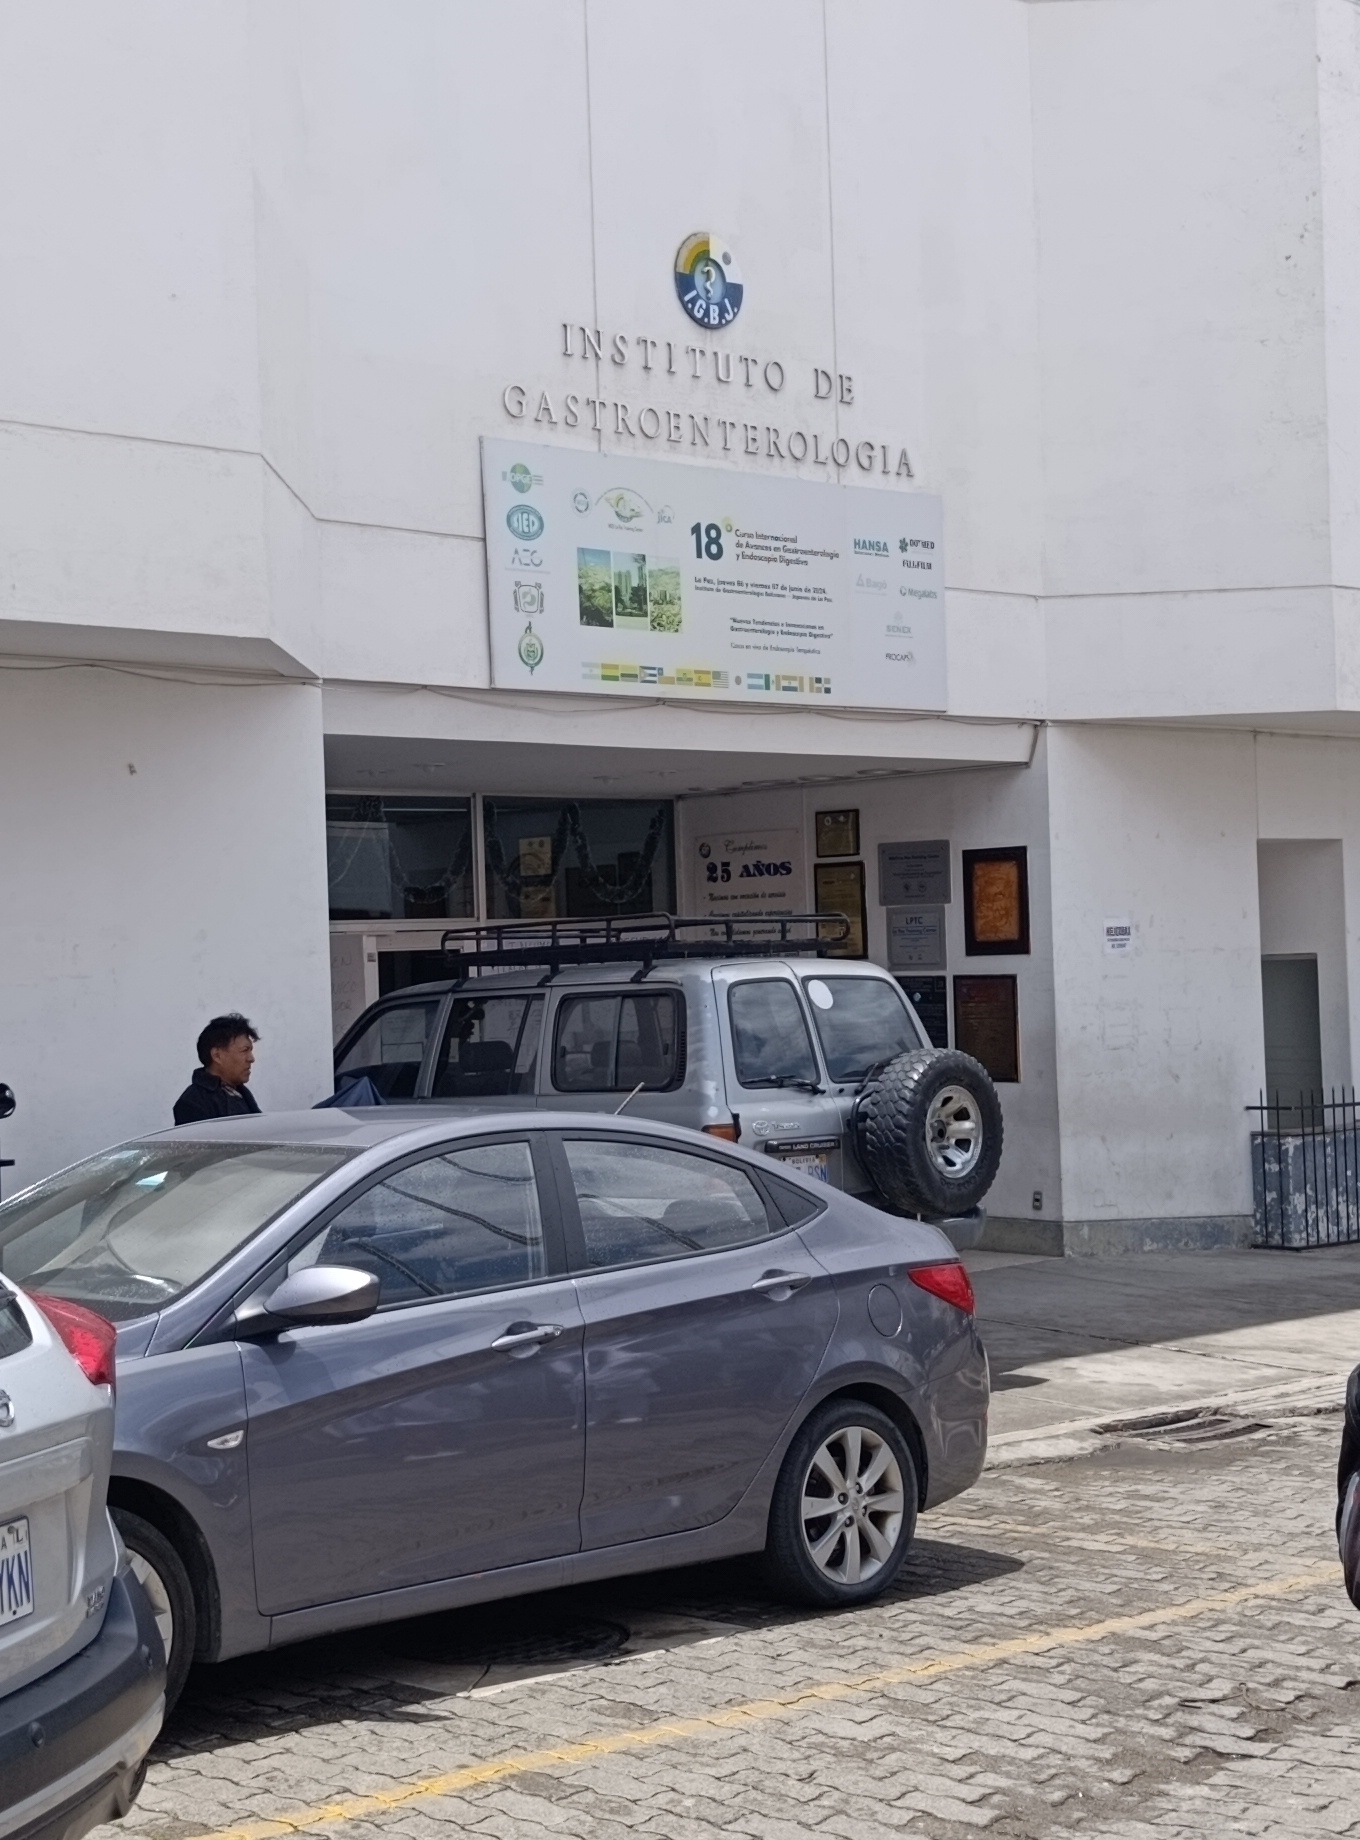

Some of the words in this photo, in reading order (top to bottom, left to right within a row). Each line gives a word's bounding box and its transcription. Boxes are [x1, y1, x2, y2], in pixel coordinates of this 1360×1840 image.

[561, 322, 785, 392] INSTITUTO
[813, 367, 855, 405] DE
[502, 383, 915, 478] GASTROENTEROLOGIA
[512, 512, 539, 534] SIED
[735, 528, 754, 539] Curso
[853, 538, 889, 553] HANSA
[706, 861, 732, 883] 25
[738, 860, 792, 878] AÑOS
[809, 1141, 835, 1149] CRUISER
